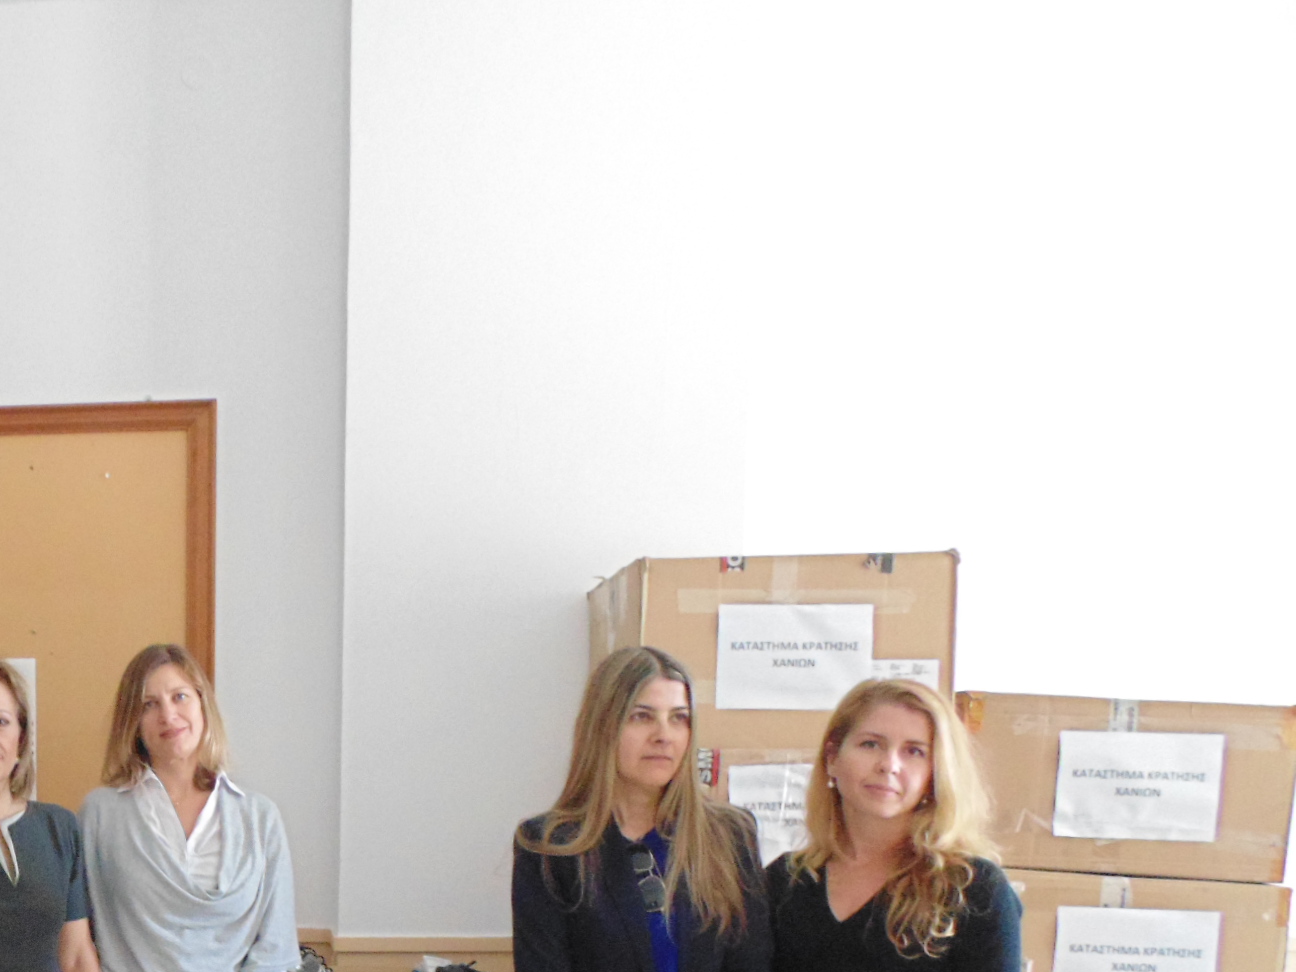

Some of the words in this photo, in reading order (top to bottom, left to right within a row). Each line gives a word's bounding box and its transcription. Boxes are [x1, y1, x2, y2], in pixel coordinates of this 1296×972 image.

[730, 641, 799, 652] ΚΑΤΑΣΤΗΜΑ
[802, 641, 859, 652] ΚΡΑΤΗΣΗΣ
[772, 658, 816, 668] ΧΑΝΙΩΝ
[1071, 768, 1144, 780] ΚΑΤΑΣΤΗΜΑ
[1147, 771, 1207, 783] ΚΡΑΤΗΣΗΣ
[1114, 787, 1162, 798] ΧΑΝΙΩΝ
[1069, 944, 1140, 956] ΚΑΤΑΣΤΗΜΑ
[1143, 946, 1204, 959] ΚΡΑΤΗΣΗΣ
[1111, 963, 1157, 972] ΧΑΝΙΩΝ
